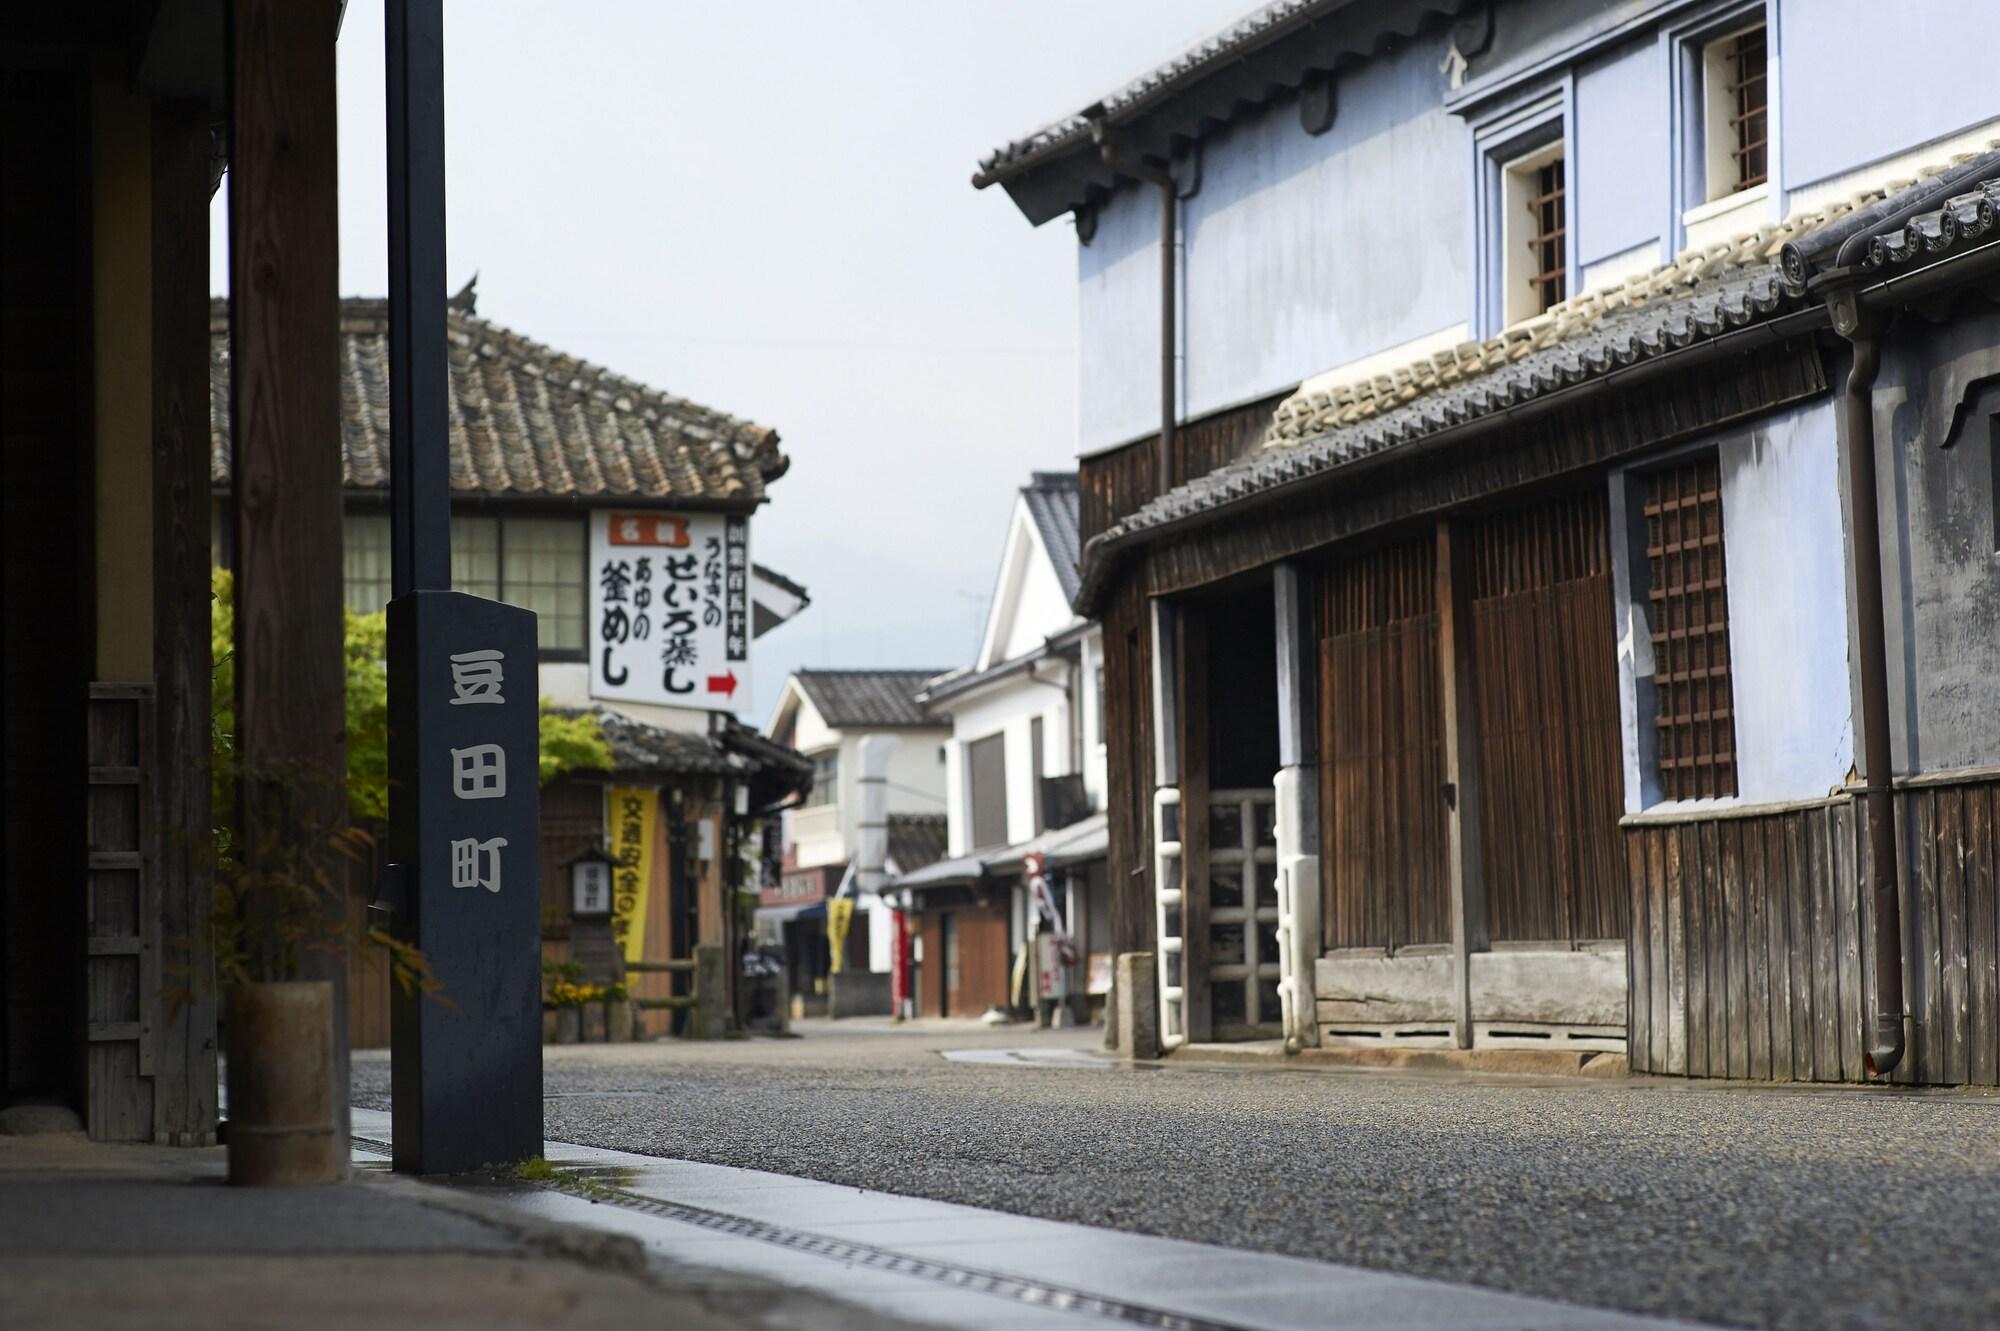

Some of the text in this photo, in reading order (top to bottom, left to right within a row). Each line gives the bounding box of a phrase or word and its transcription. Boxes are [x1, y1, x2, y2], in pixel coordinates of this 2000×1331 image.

[601, 560, 631, 687] 釜めし
[633, 555, 652, 641] あゆの
[661, 554, 699, 694] せいろ蒸し
[449, 649, 509, 893] 豆田町
